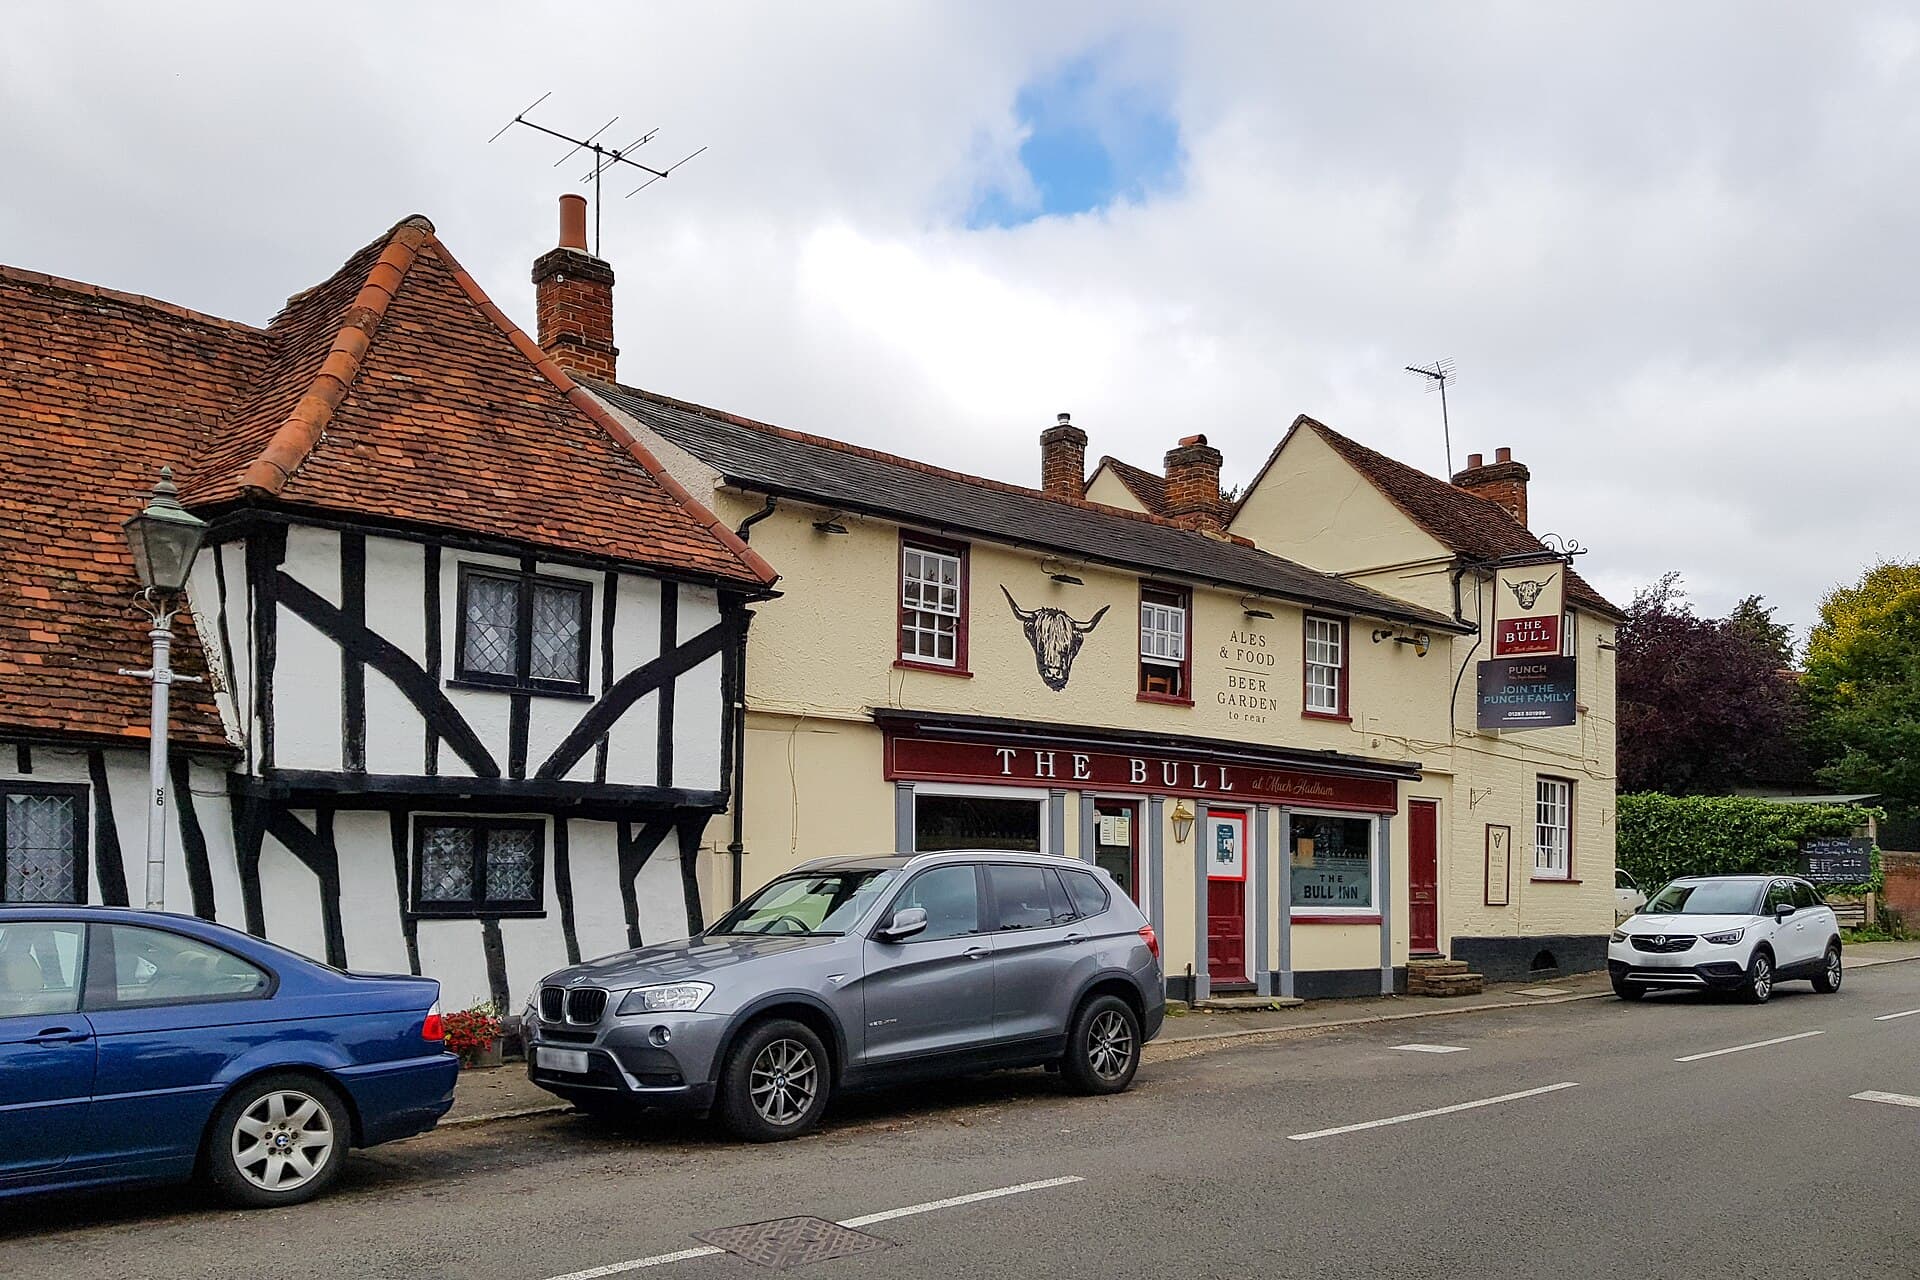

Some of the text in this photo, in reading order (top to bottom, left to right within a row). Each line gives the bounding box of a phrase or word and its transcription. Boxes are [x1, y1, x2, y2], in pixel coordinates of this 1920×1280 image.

[1514, 620, 1542, 630] THE
[1229, 630, 1267, 647] ALES
[1505, 630, 1550, 643] BULL
[1219, 646, 1275, 667] & FOOD
[1508, 665, 1547, 674] PUNCH
[1228, 675, 1267, 692] BEER
[1500, 684, 1554, 694] JOIN THE
[1217, 691, 1278, 711] GARDEN
[1484, 693, 1571, 704] PUNCH FAMILY
[1229, 711, 1267, 723] to rear
[996, 748, 1334, 796] THE BULL at Much Hadham
[1319, 874, 1344, 883] THE
[1304, 885, 1358, 899] BULL INN
